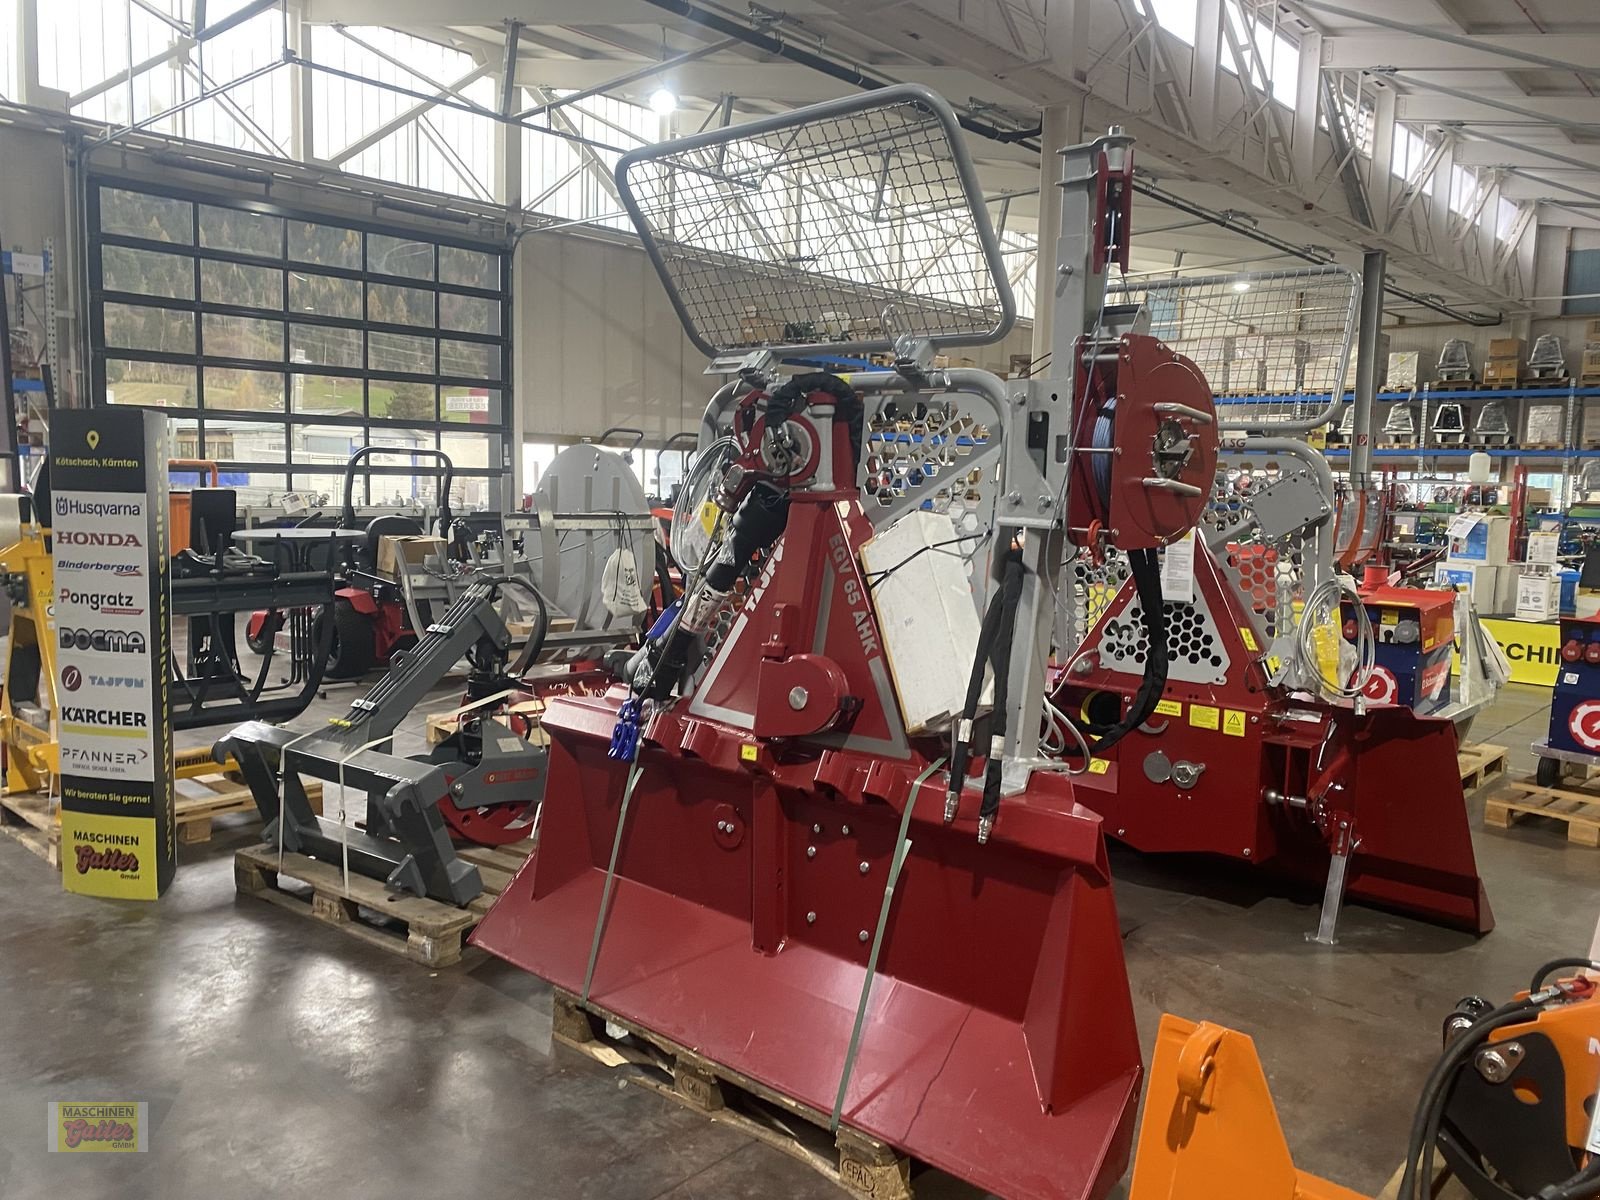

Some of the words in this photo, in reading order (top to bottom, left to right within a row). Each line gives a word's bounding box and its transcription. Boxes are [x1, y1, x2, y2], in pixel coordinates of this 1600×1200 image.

[1230, 438, 1246, 448] SG
[55, 458, 101, 467] Kötschach,
[102, 458, 138, 468] Kärnten
[69, 498, 140, 517] Husqvarna
[56, 531, 142, 547] HONDA
[829, 534, 854, 574] EGV
[57, 560, 140, 572] Binderberger
[59, 589, 133, 610] Pongratz
[844, 579, 861, 605] 65
[852, 611, 878, 656] AHK
[89, 675, 144, 688] TAJFUN
[62, 706, 146, 726] KÄRCHER
[62, 748, 137, 764] PFANNER
[65, 788, 76, 797] Wir
[77, 789, 107, 801] beraten
[109, 792, 121, 802] Sie
[122, 795, 151, 805] gerne!
[74, 831, 139, 846] MASCHINEN
[846, 1162, 869, 1188] EPAL
